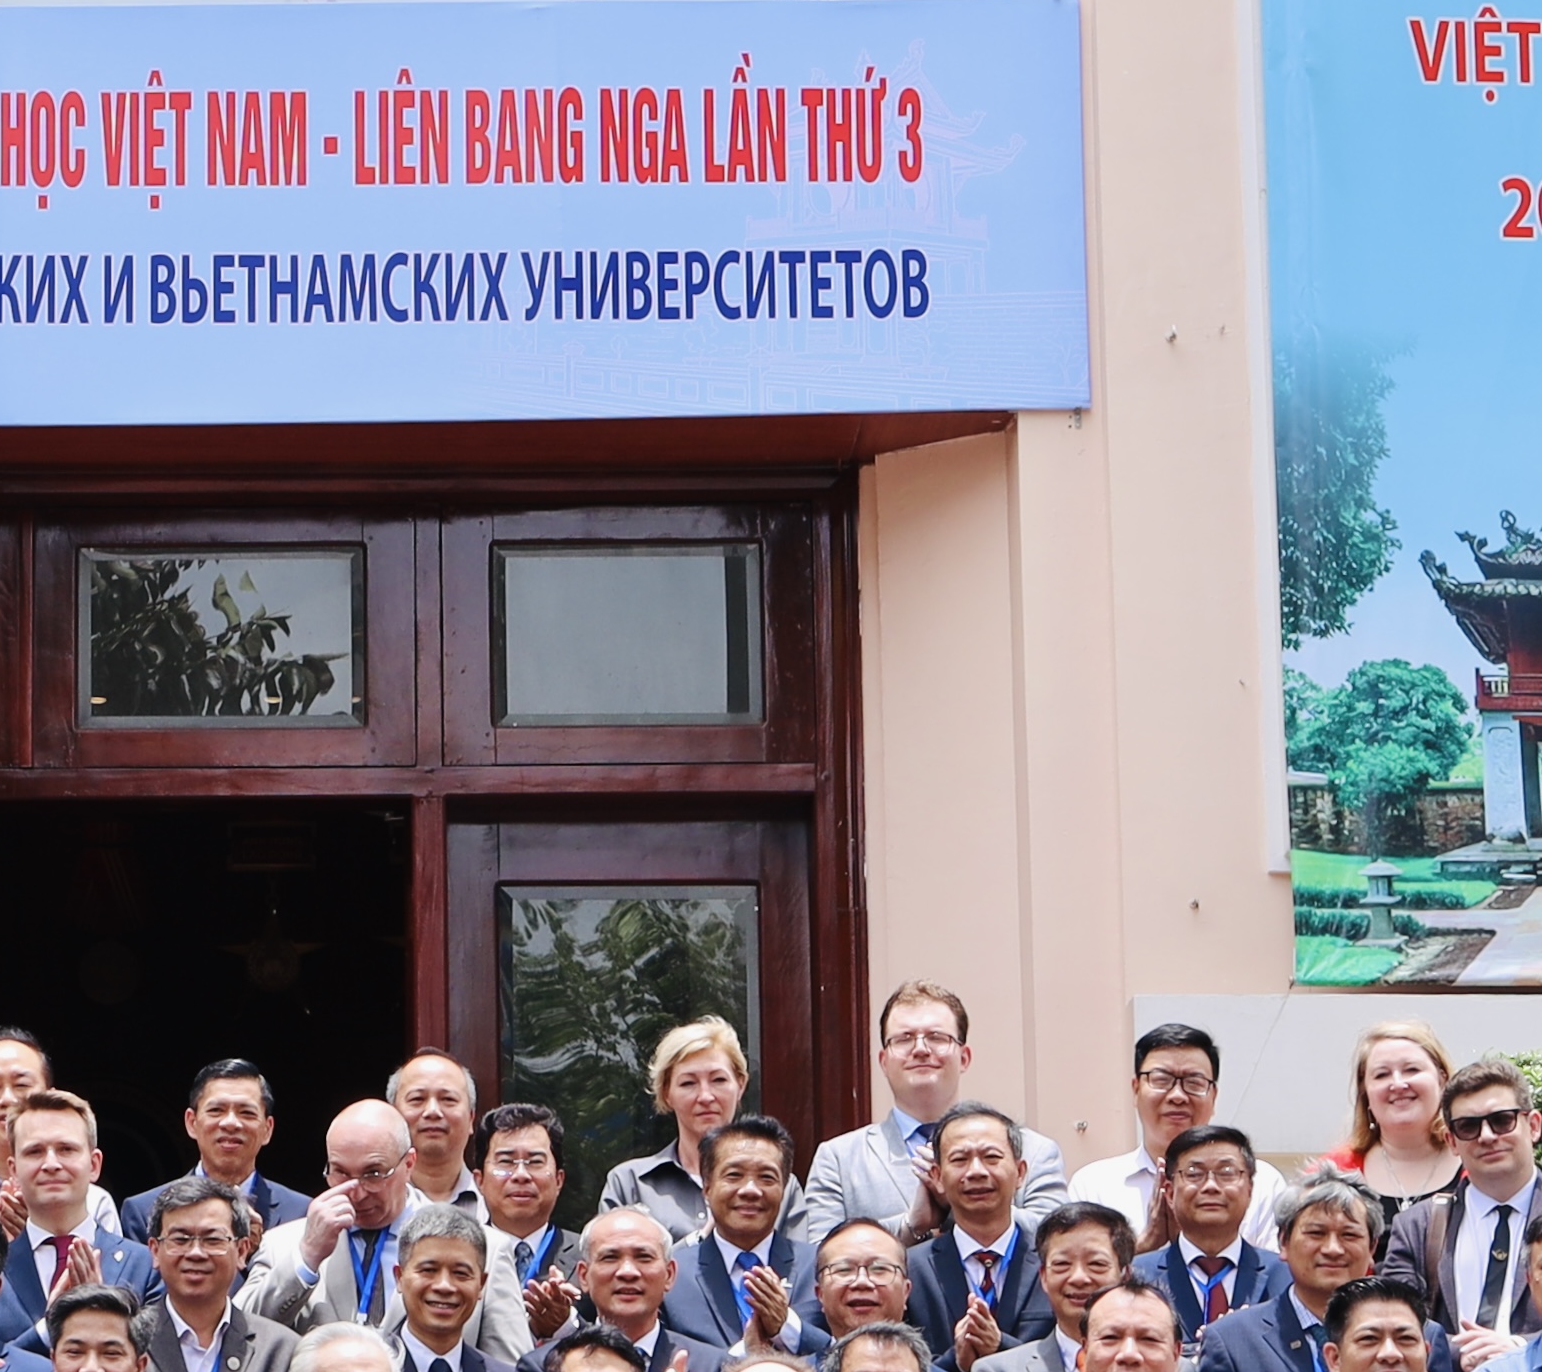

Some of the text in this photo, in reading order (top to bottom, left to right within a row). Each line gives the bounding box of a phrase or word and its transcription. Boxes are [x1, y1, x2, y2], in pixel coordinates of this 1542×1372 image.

[0, 89, 88, 211] HỌC
[100, 69, 194, 211] VIỆT
[206, 89, 309, 188] NAM
[353, 67, 451, 187] LIÊN
[464, 85, 586, 186] BANG
[598, 85, 691, 186] NGA
[702, 52, 789, 185] LẦN
[800, 65, 889, 185] THỨ
[896, 86, 925, 184] 3
[103, 254, 135, 325] И
[149, 251, 510, 325] ВЬЕТНАМСКИХ
[519, 247, 931, 322] УНИВЕРСИТЕТОВ
